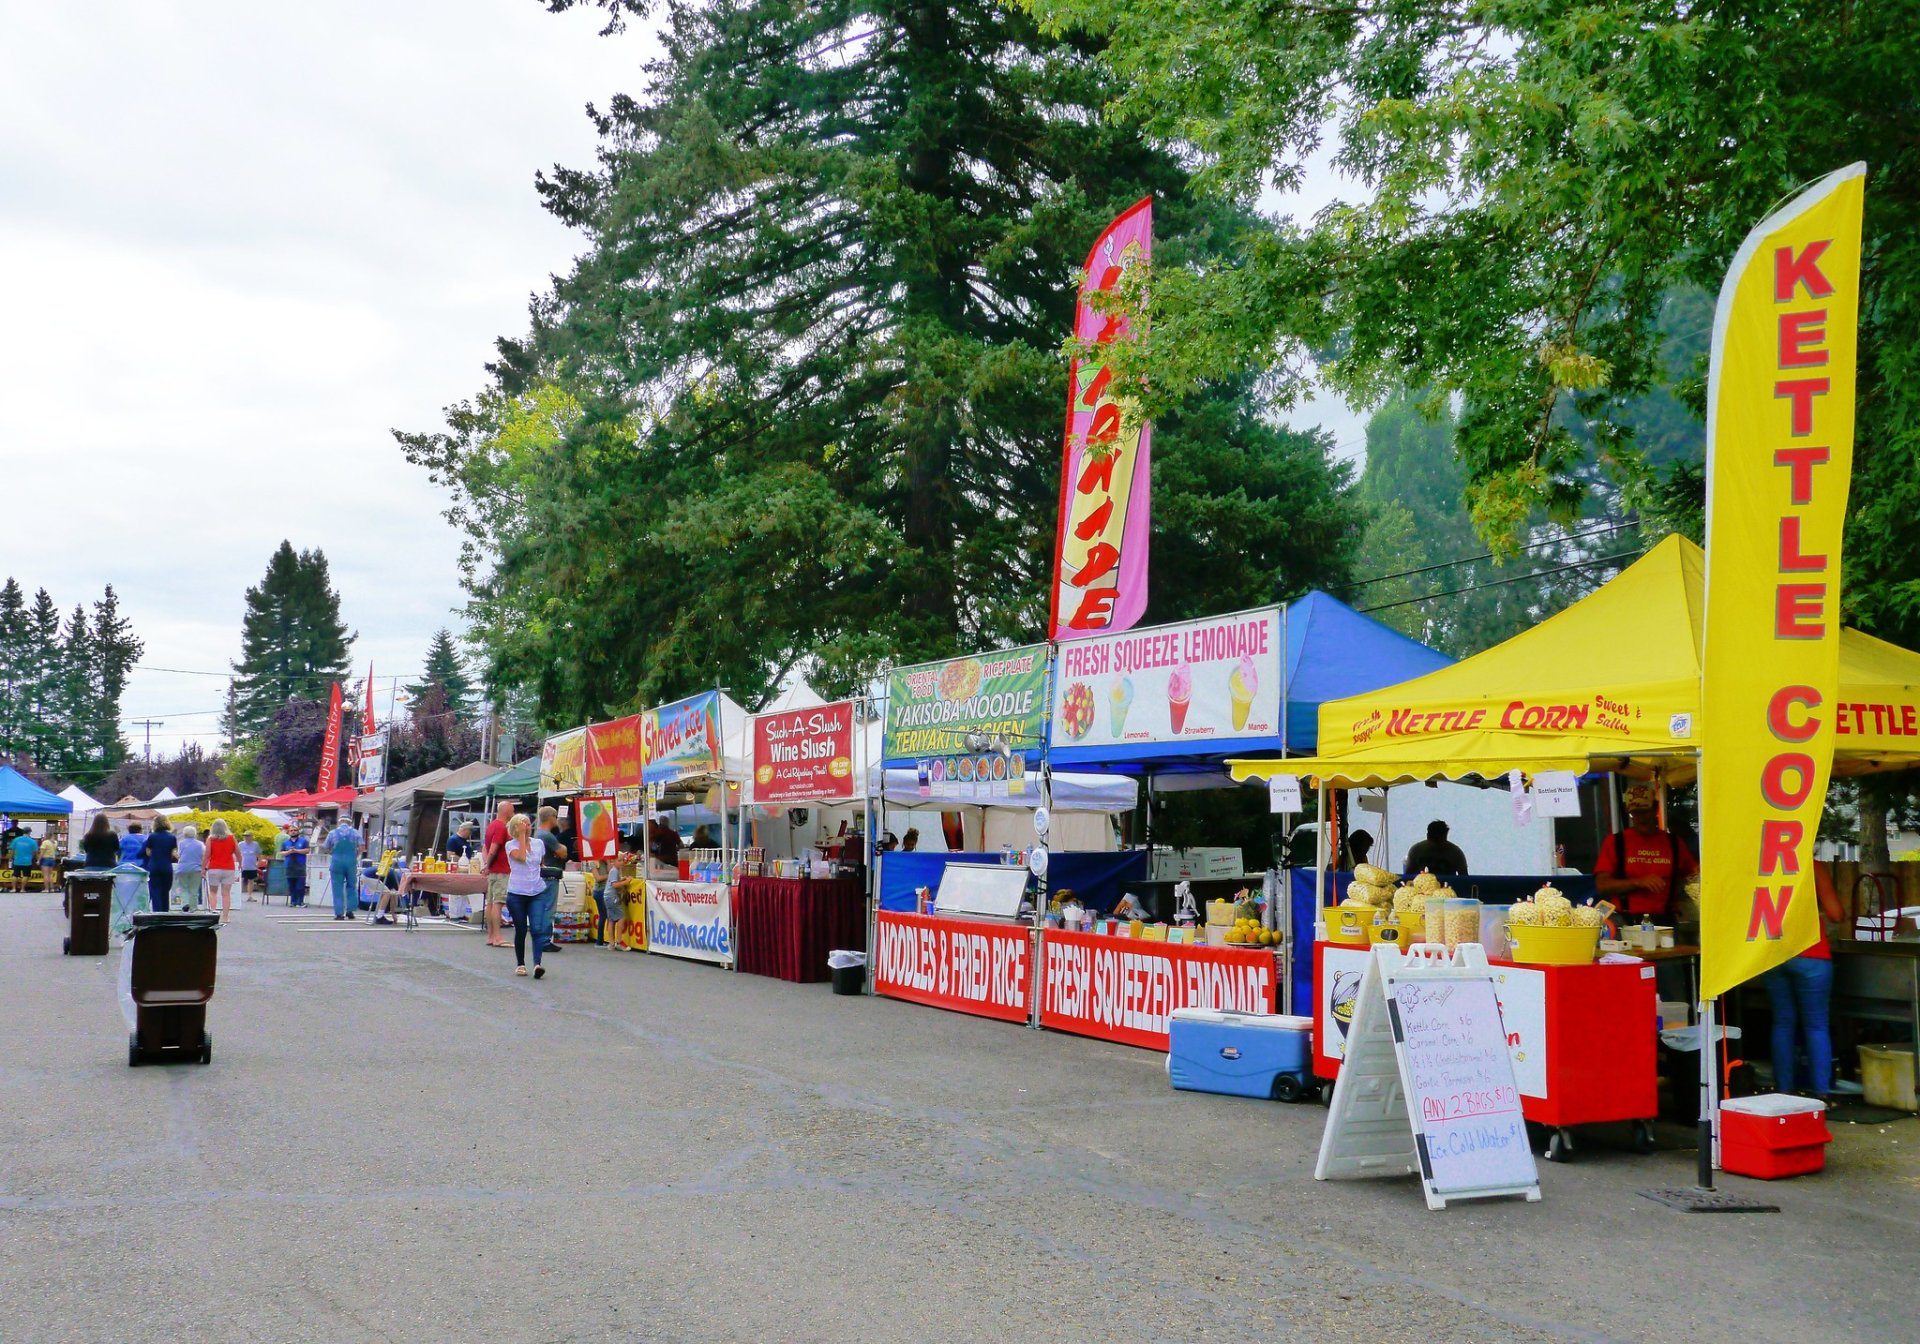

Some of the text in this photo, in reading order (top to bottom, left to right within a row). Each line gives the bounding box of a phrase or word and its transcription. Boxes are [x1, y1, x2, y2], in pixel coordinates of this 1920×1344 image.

[1071, 265, 1123, 630] ONADE
[1746, 239, 1836, 942] KETTLE CORN
[1064, 619, 1268, 678] FRESH SQUEEZE LEMONADE
[906, 671, 938, 686] ORIENTAL
[983, 655, 1034, 679] RICE PLATE
[912, 684, 934, 699] FOOD
[1595, 694, 1631, 717] Sweet
[895, 690, 1033, 729] YAKISOBA NOODLE
[1385, 700, 1590, 737] KETTLE CORN
[1595, 713, 1631, 736] Salty
[1836, 703, 1918, 736] ETTLE
[644, 708, 681, 767] Shaved
[765, 712, 843, 742] Such-A-Slush
[895, 719, 1026, 754] TERIYAKI CCKEN
[1124, 730, 1150, 740] Lemonade
[1184, 725, 1216, 736] Strawberry
[1248, 722, 1269, 732] Mango
[770, 736, 835, 763] Wine Slush
[655, 886, 719, 907] Fresh Squeezed
[649, 909, 730, 954] Lemonade
[878, 921, 1025, 1009] NOODLES & FRIED RICE
[1046, 942, 1091, 1021] FRESH
[1092, 947, 1174, 1035] SQUEEZED
[1423, 1086, 1516, 1120] ANY 2 BAGS $10
[1426, 1121, 1526, 1160] Ice Cold Water $1
